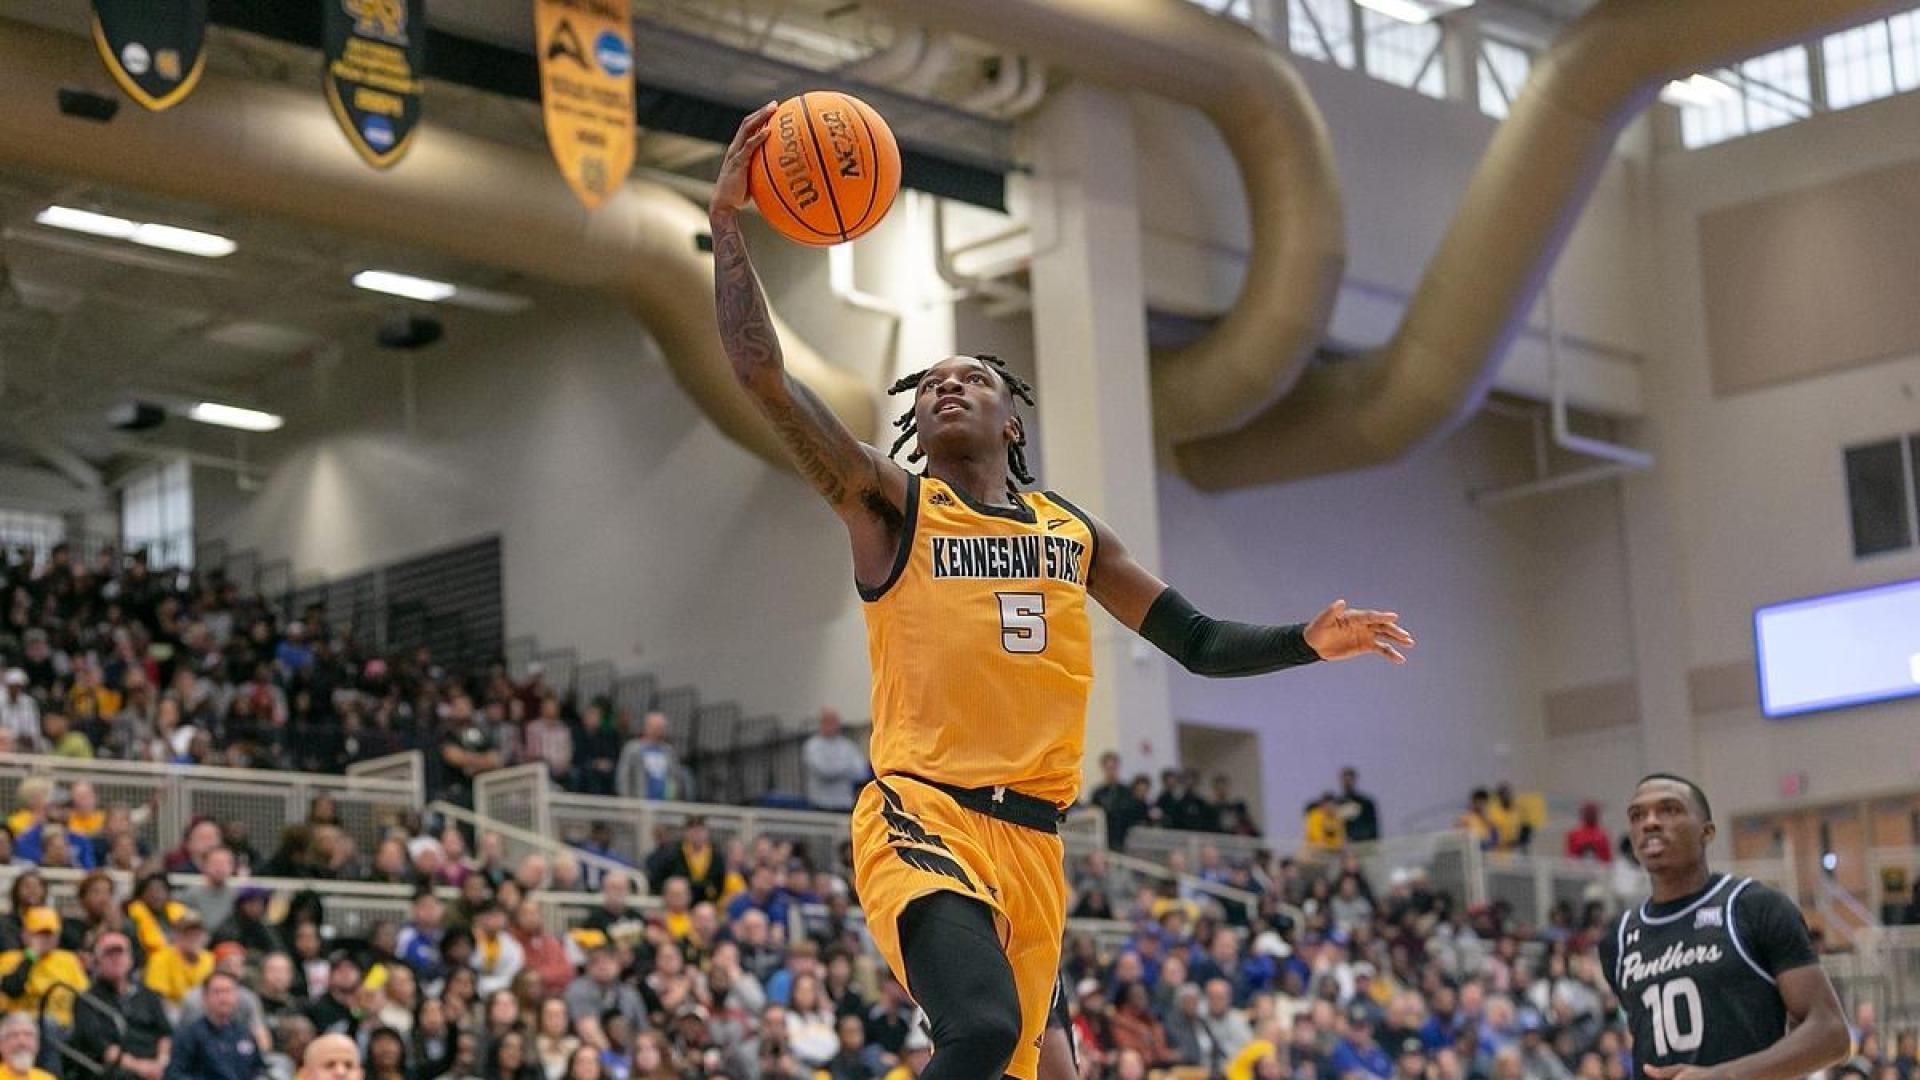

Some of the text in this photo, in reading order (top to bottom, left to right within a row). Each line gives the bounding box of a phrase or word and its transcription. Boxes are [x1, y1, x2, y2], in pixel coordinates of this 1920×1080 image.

[778, 112, 819, 209] Wilson
[932, 536, 1040, 579] KENNESAW
[994, 591, 1047, 654] 5
[1622, 940, 1723, 990] Panthers
[1641, 976, 1705, 1057] 10
